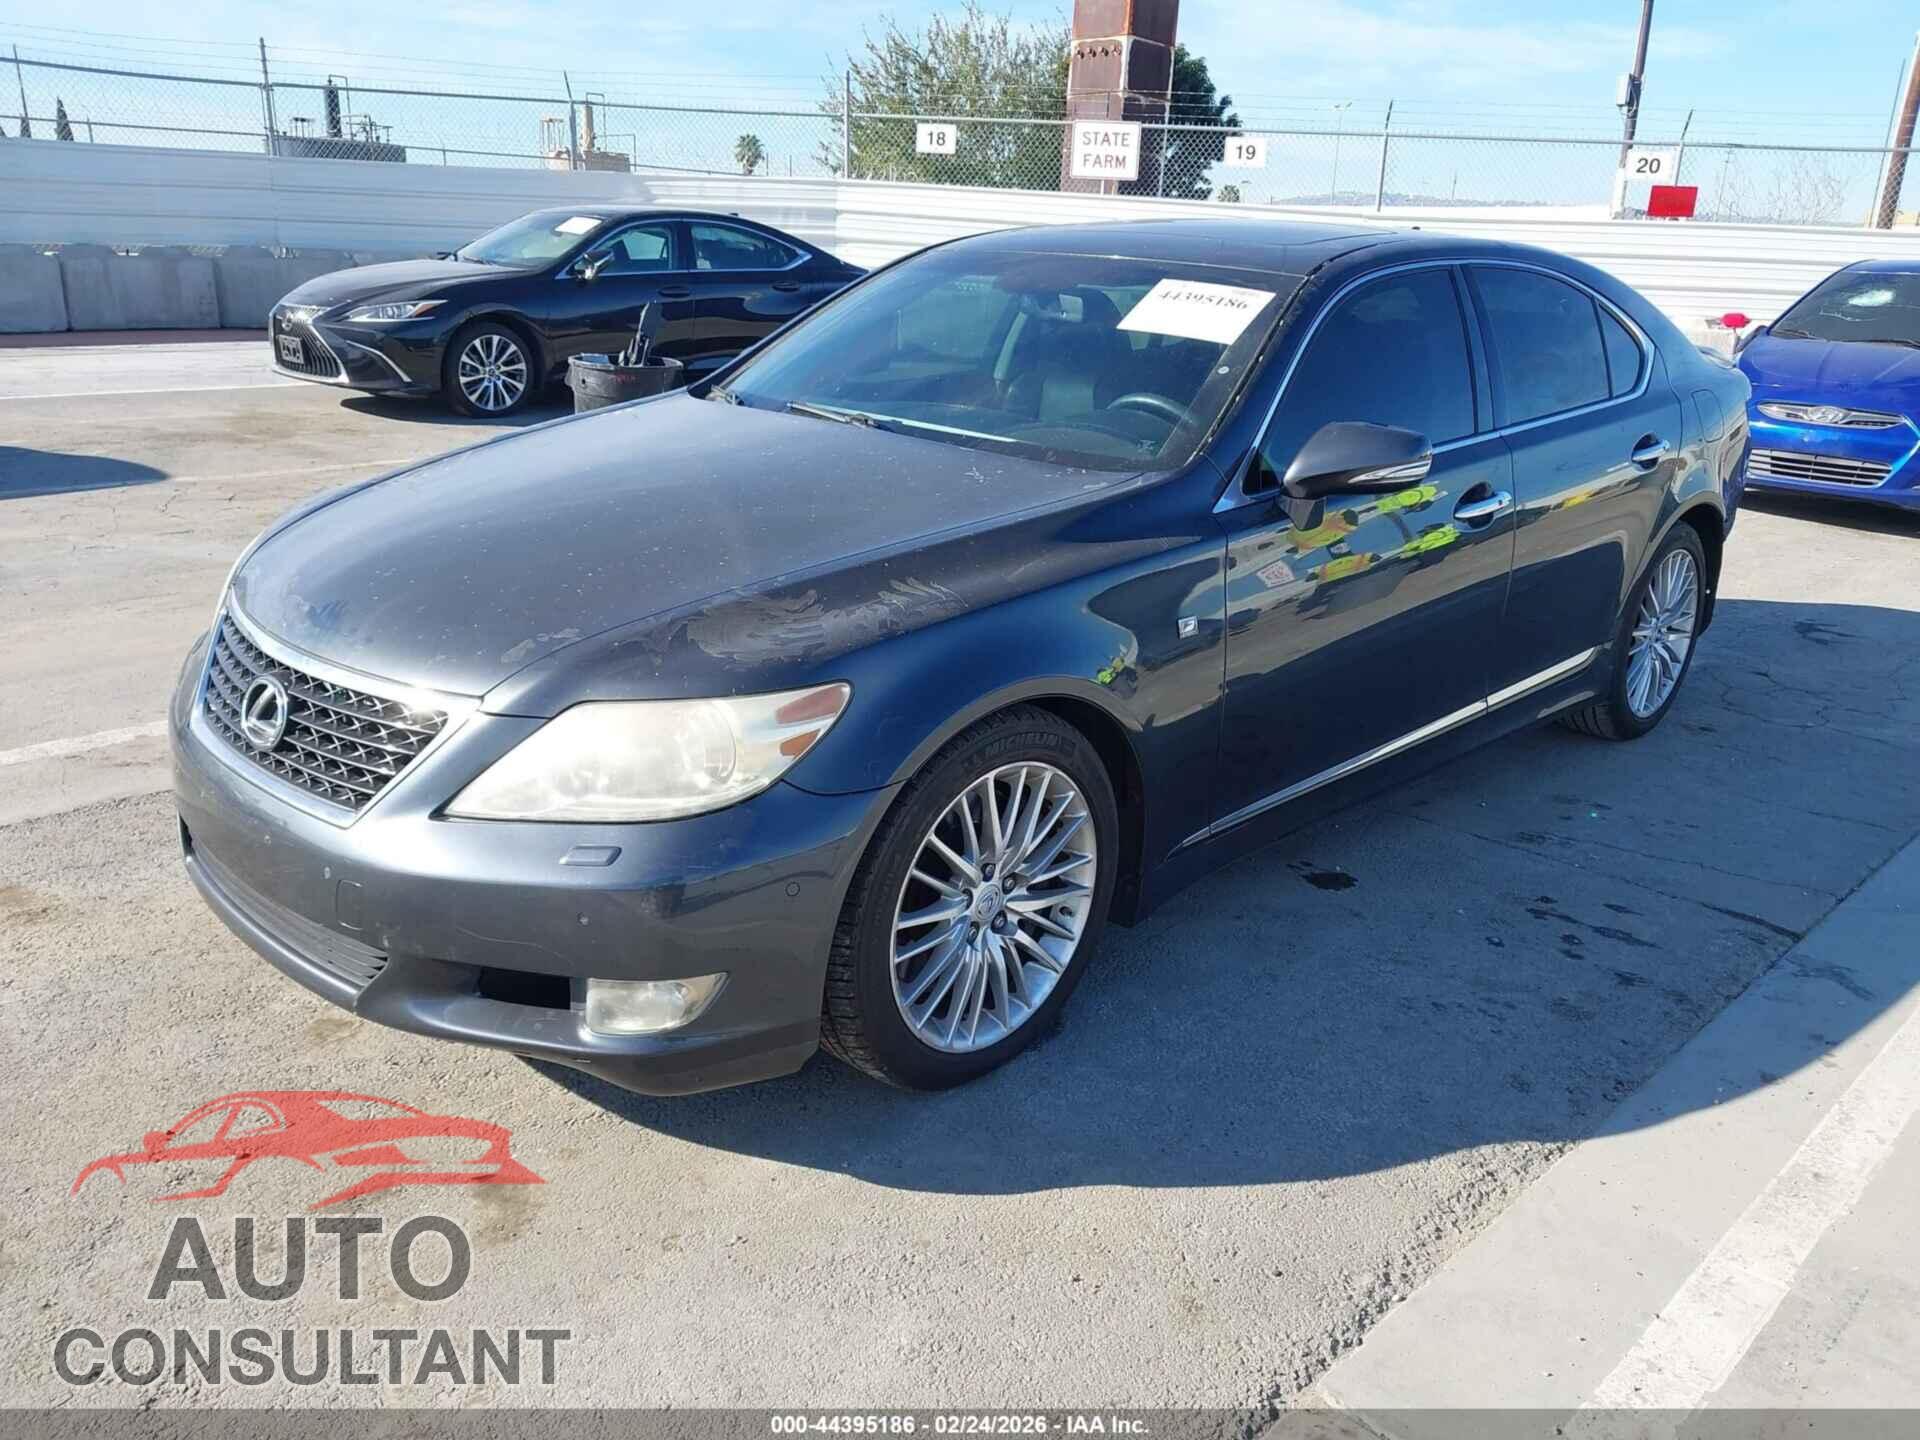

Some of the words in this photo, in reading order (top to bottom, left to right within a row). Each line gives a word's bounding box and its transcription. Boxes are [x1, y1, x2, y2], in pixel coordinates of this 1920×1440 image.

[928, 131, 948, 147] 18
[1082, 131, 1130, 147] STATE
[1237, 144, 1256, 160] 19
[1083, 153, 1127, 169] FARM
[1636, 157, 1661, 174] 20
